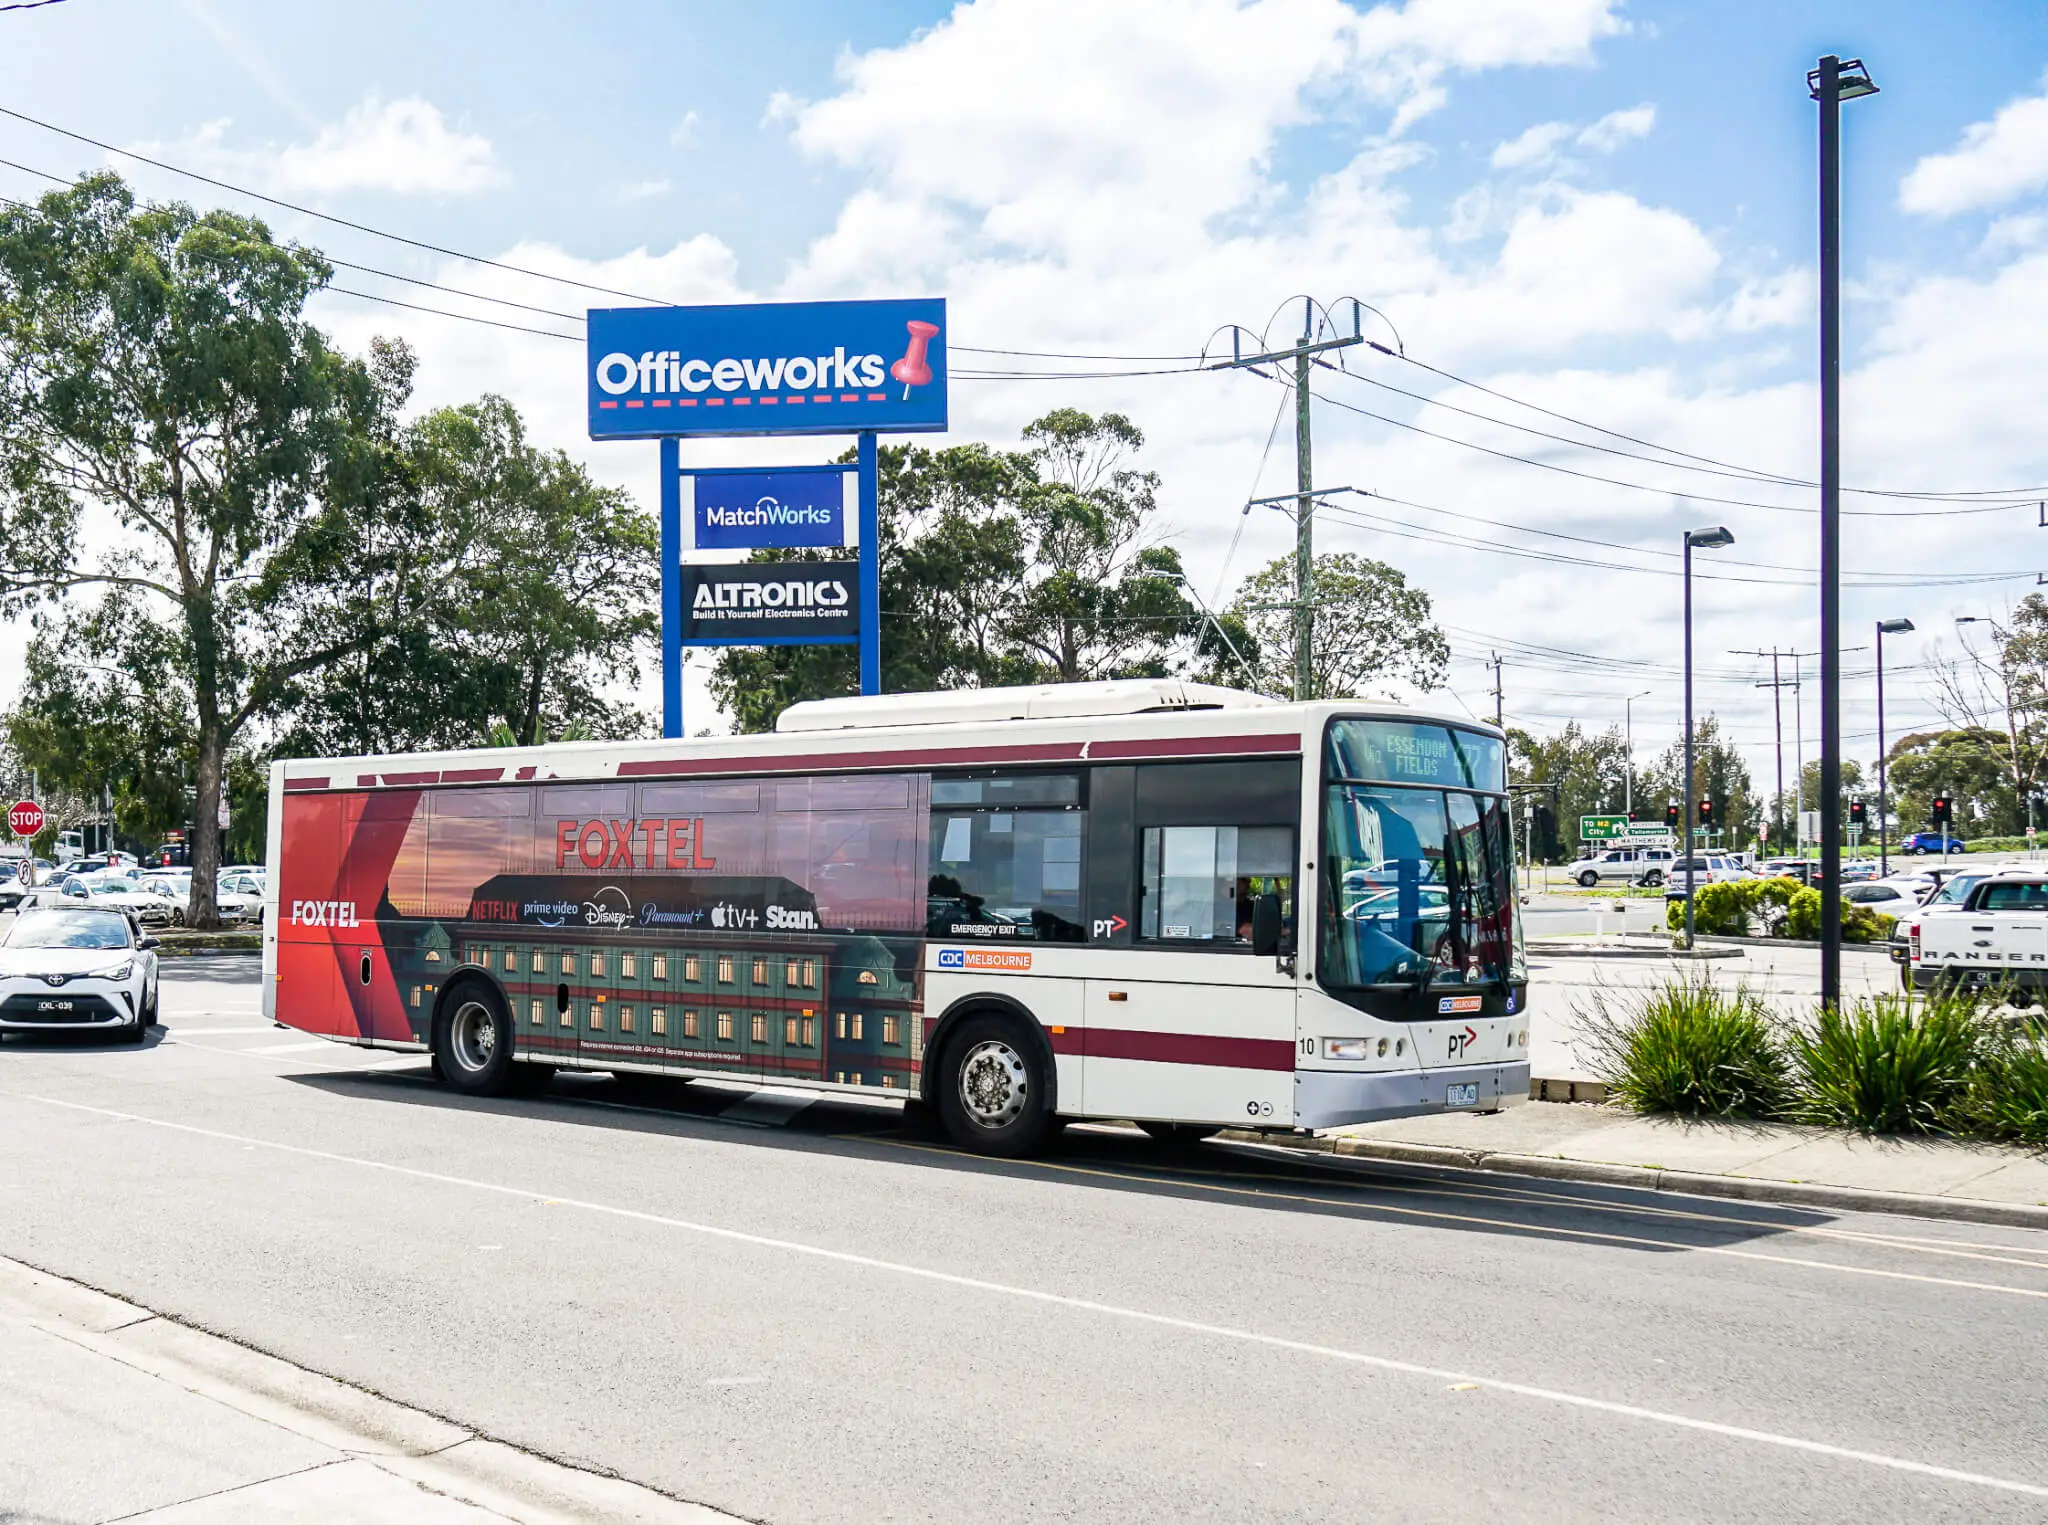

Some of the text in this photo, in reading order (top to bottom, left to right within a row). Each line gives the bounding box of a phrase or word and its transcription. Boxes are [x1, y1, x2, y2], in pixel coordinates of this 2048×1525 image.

[596, 346, 885, 395] Officeworks
[706, 496, 832, 527] MatchWorks
[692, 580, 849, 609] ALTRONICS
[692, 608, 716, 619] Build
[726, 608, 762, 619] Yourself
[764, 608, 816, 618] Electronics
[817, 607, 849, 617] Centre
[1395, 754, 1439, 776] FIELDS
[10, 811, 42, 826] STOP
[555, 817, 717, 870] FOXTEL
[291, 899, 360, 929] FOXTEL
[472, 900, 518, 922] NETFLIX
[524, 900, 579, 916] prime video
[951, 924, 1016, 935] EMERGENCY EXIT
[939, 952, 1031, 967] CDC MELBOURNE
[1924, 951, 2046, 961] RANGER
[1300, 1037, 1315, 1055] 10
[1448, 1034, 1467, 1059] PT
